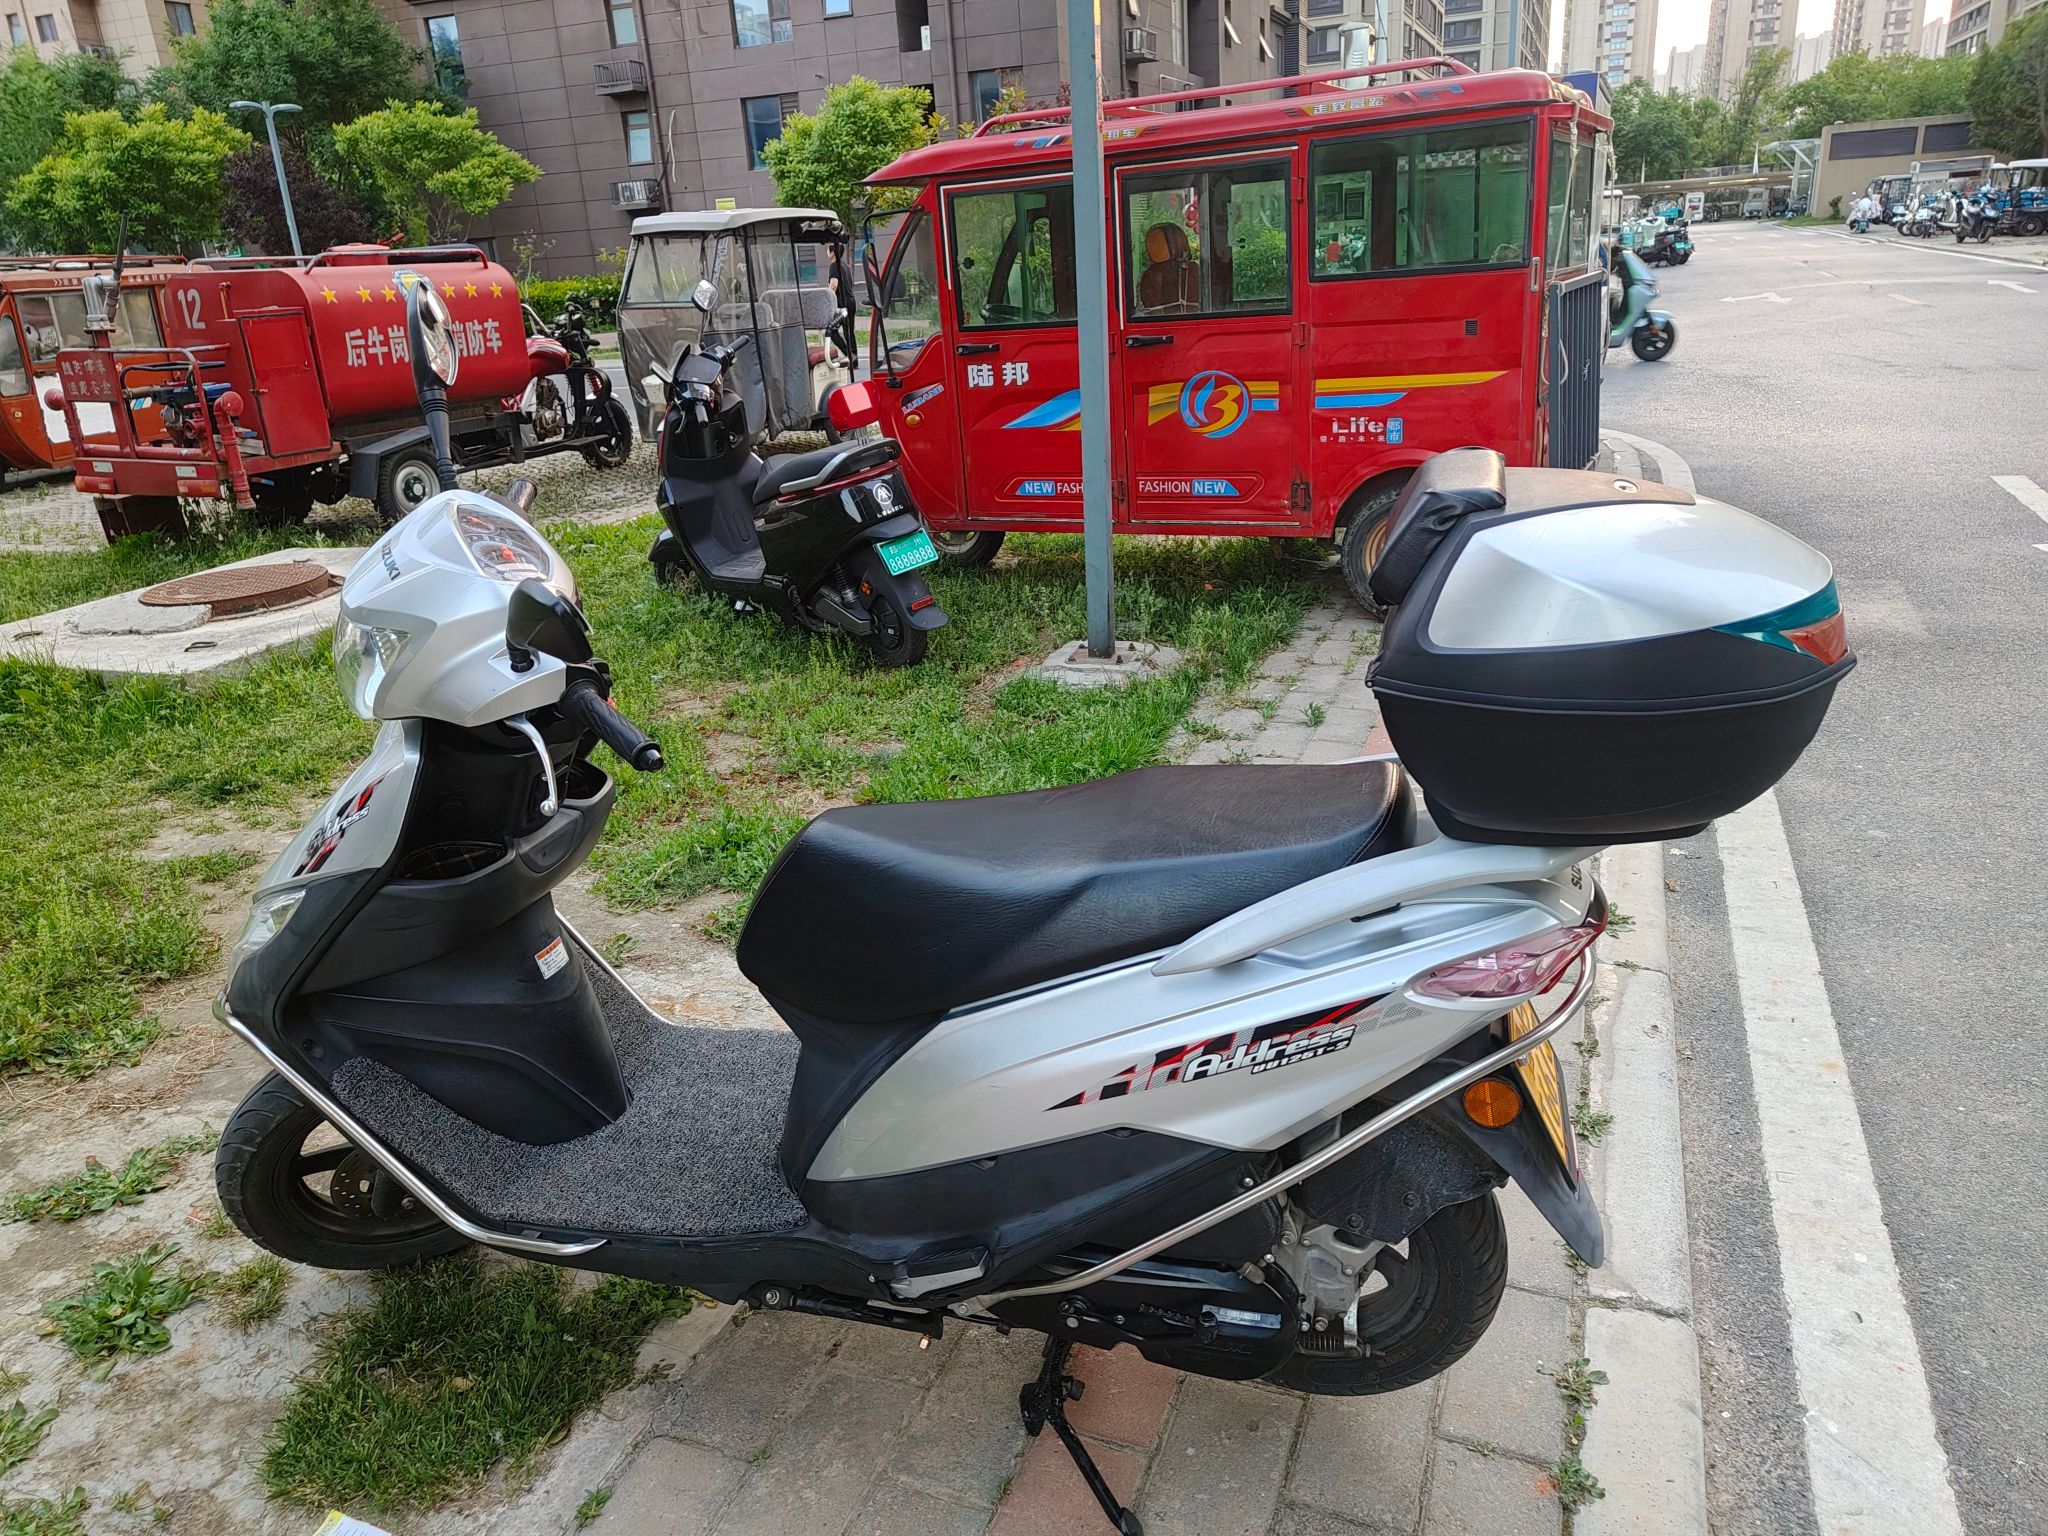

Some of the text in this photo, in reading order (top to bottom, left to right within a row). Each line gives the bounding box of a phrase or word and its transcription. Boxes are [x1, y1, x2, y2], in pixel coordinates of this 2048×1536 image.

[178, 288, 206, 329] 12
[967, 361, 1030, 388] 陆邦
[1332, 416, 1384, 434] Life
[1025, 481, 1053, 494] NEW
[1139, 480, 1227, 494] FASHION NEW
[381, 538, 401, 581] UZUKI
[889, 545, 934, 571] 8888888
[1182, 1025, 1356, 1083] Address
